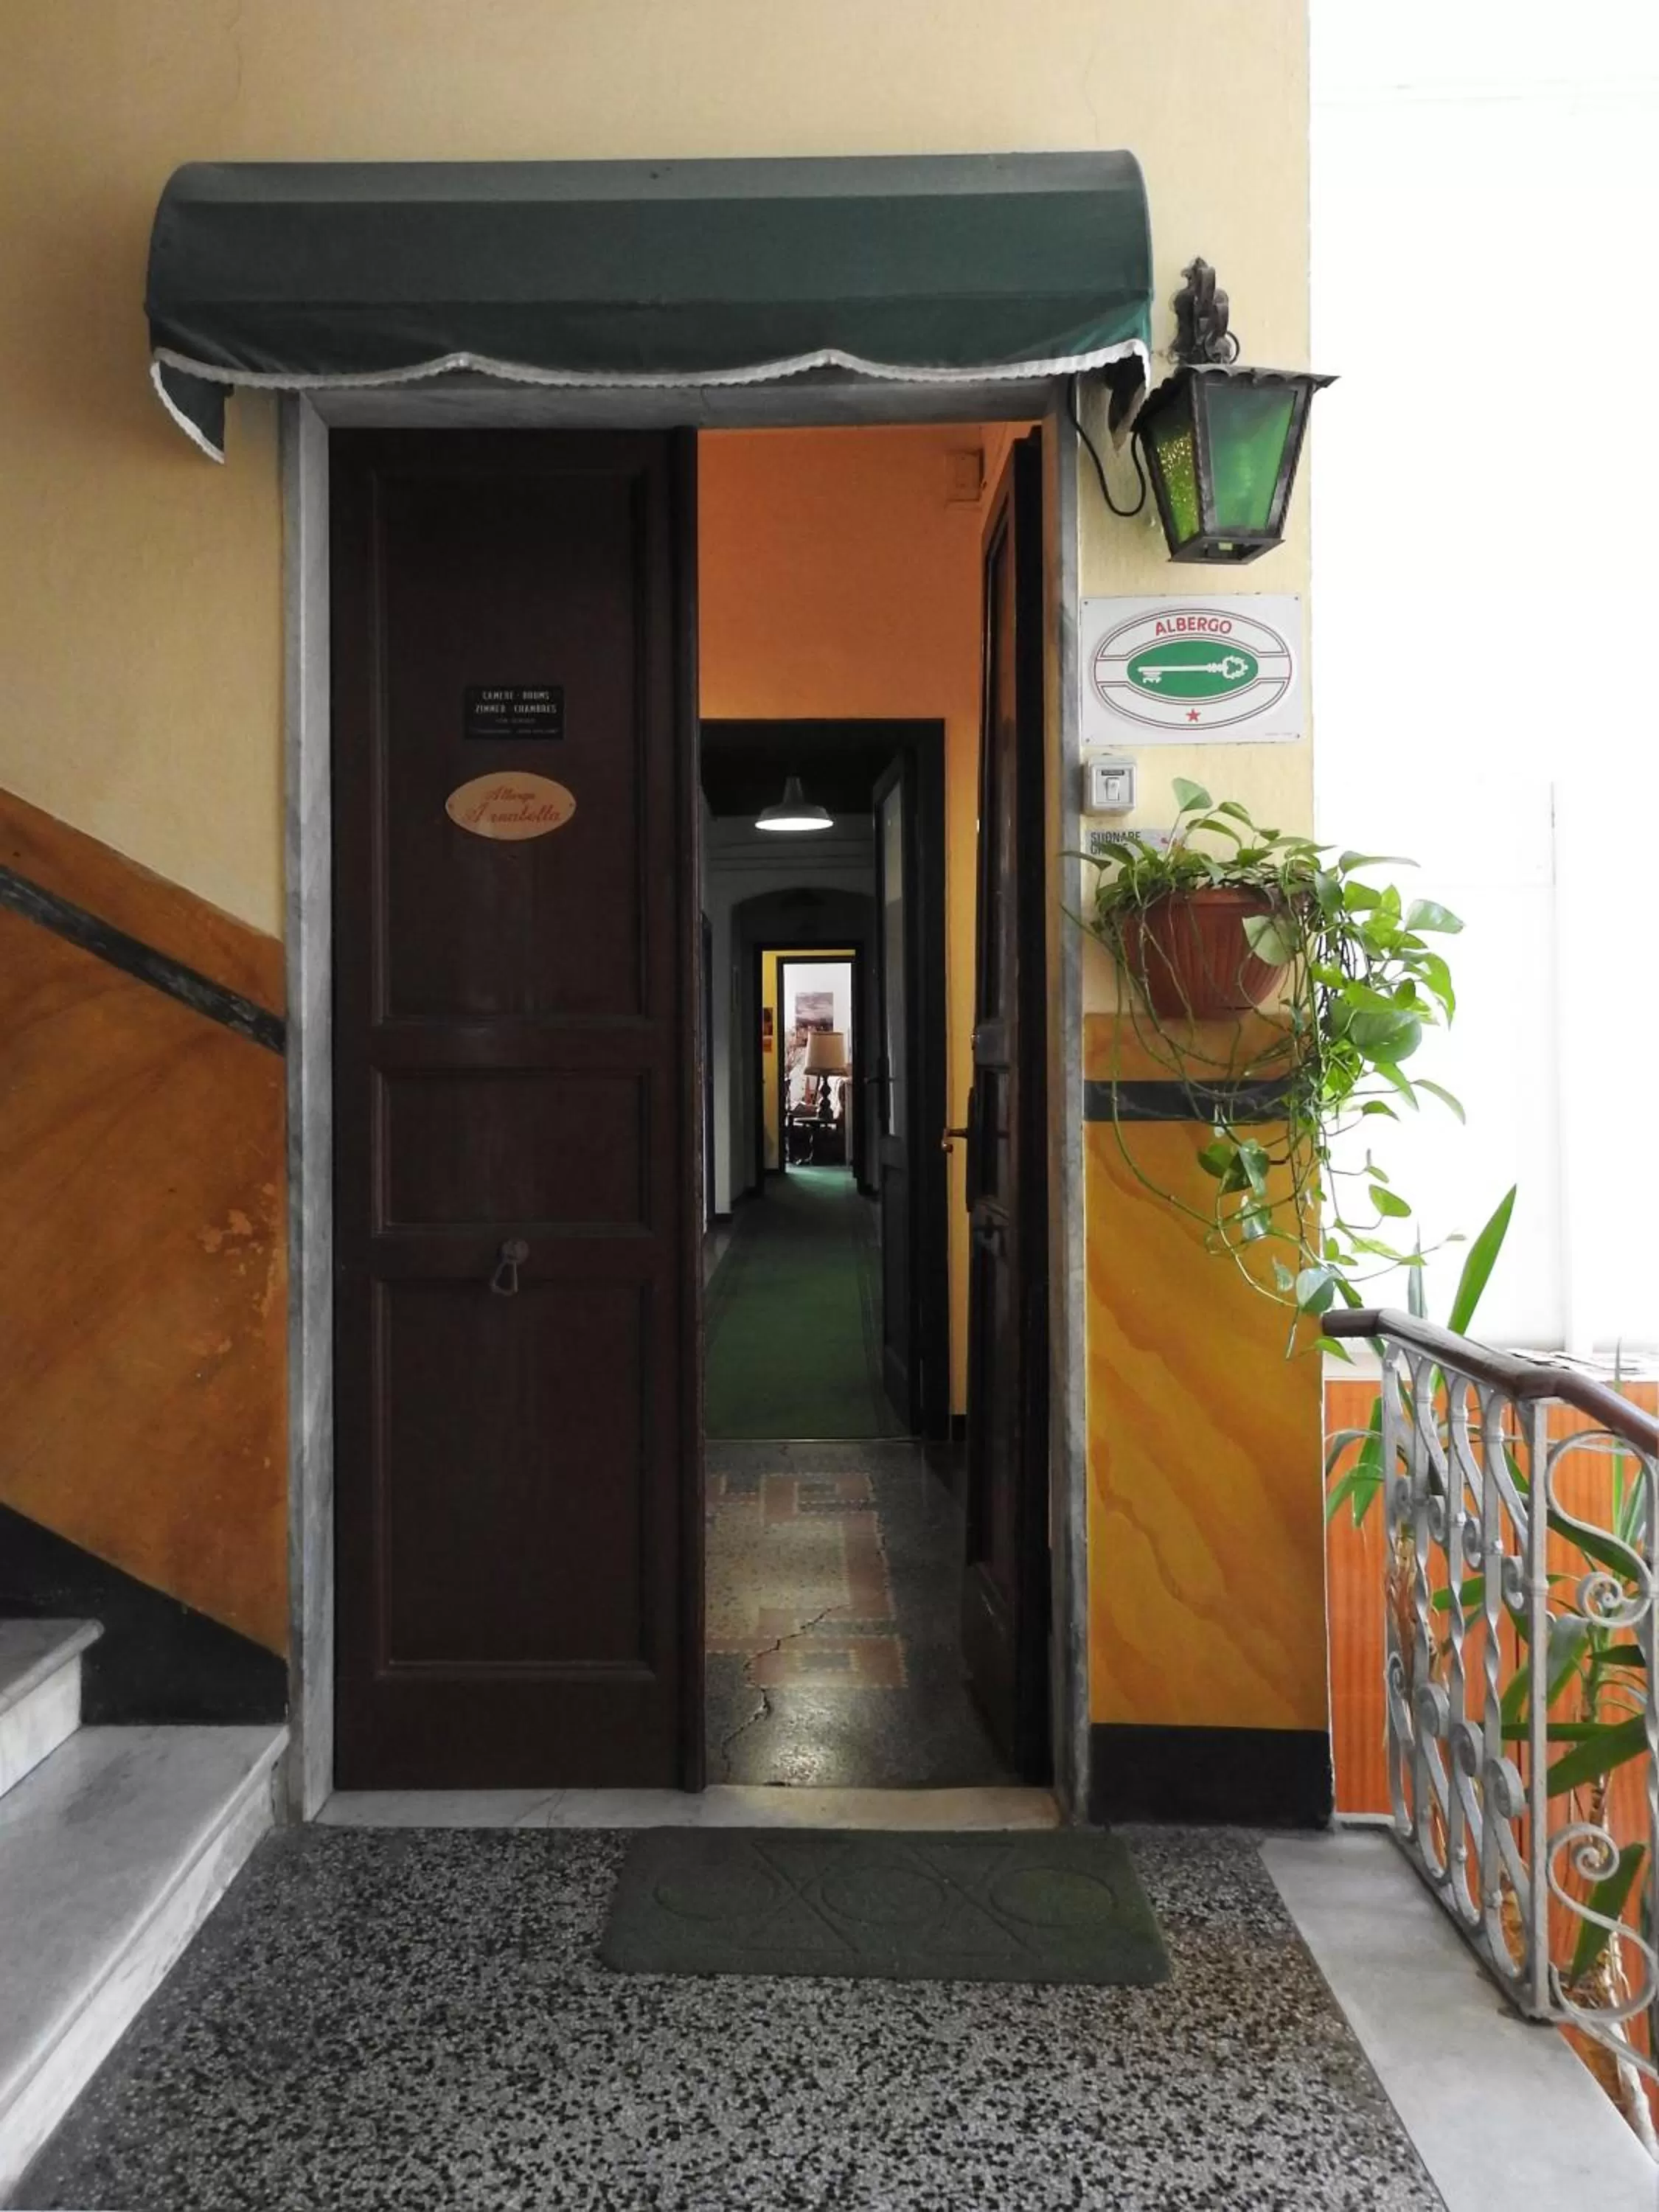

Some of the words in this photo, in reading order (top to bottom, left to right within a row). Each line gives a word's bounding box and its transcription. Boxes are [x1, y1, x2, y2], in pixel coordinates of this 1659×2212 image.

[1155, 616, 1232, 636] ALBERGO
[523, 690, 549, 700] ROOMS
[475, 703, 506, 714] ZIMMER
[514, 703, 557, 714] CHAMBRES
